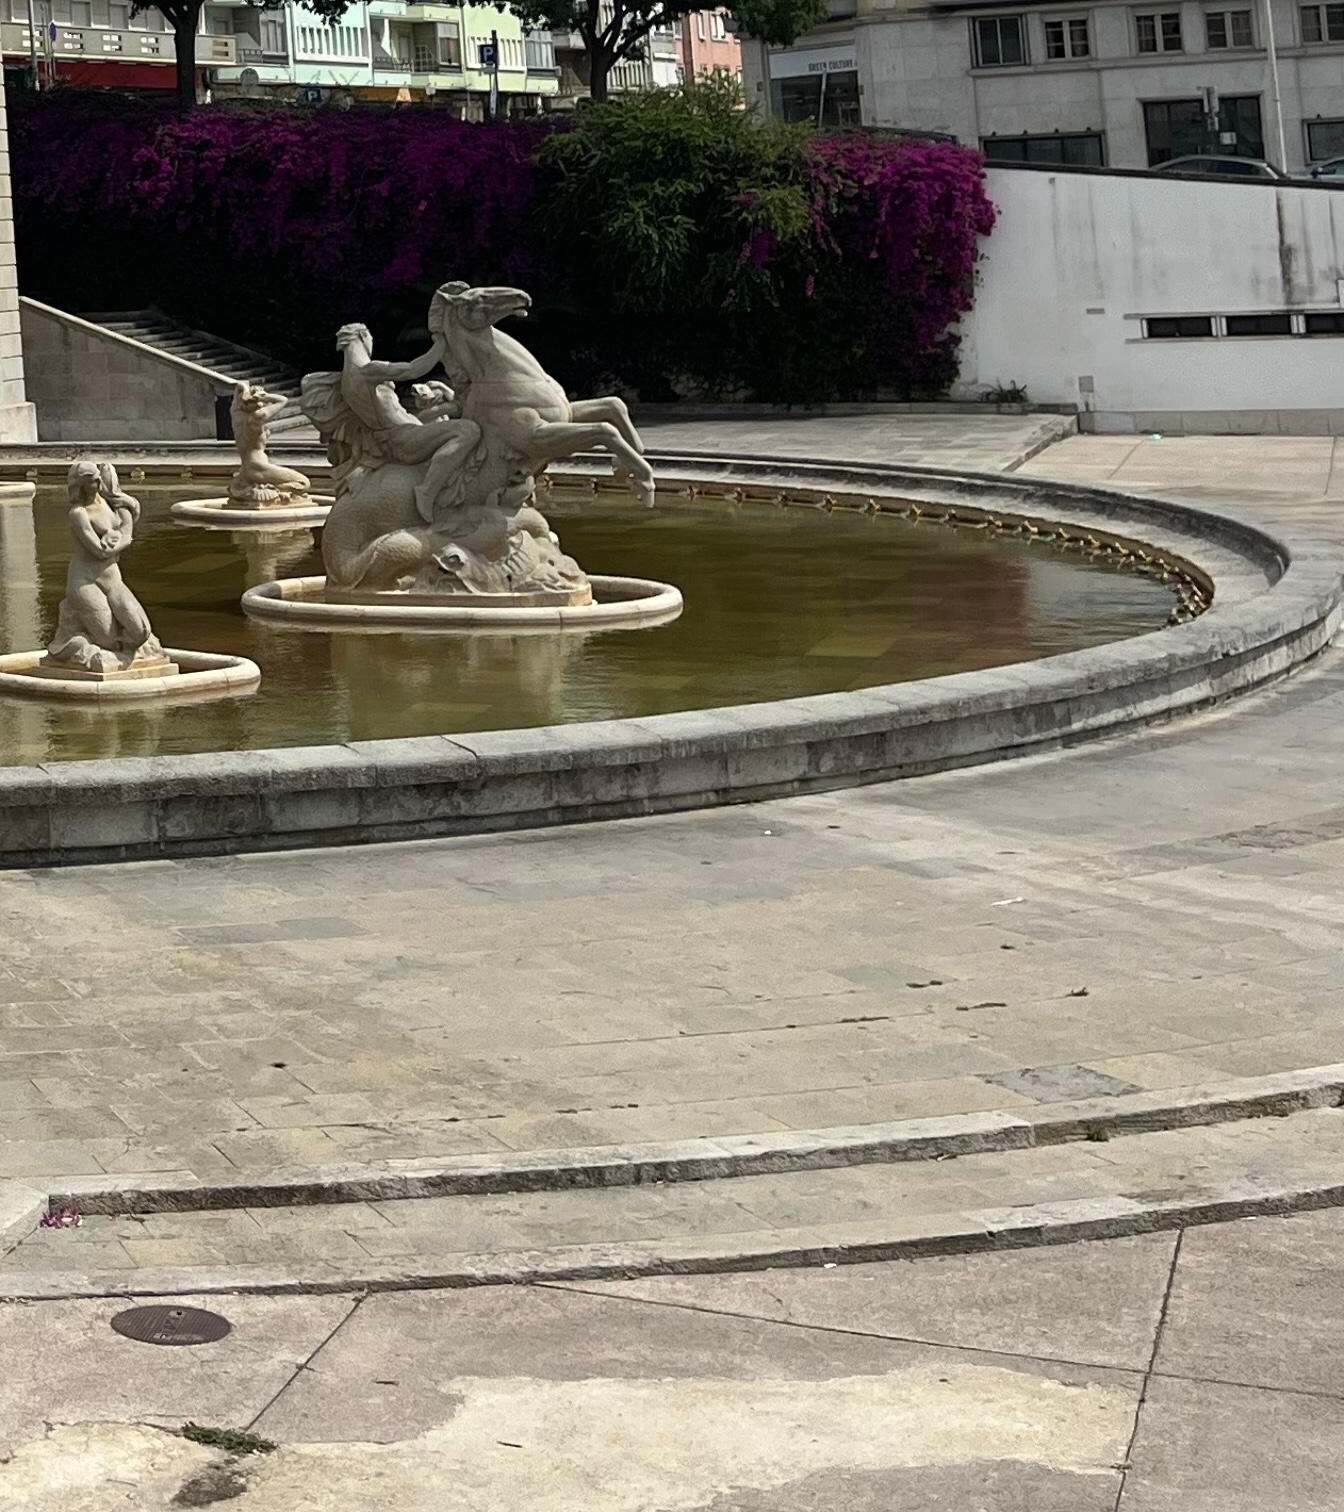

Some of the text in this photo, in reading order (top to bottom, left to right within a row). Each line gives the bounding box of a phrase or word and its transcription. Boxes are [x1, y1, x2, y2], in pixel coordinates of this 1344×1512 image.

[484, 47, 493, 60] P
[828, 59, 853, 70] CULTURE
[307, 91, 318, 102] P
